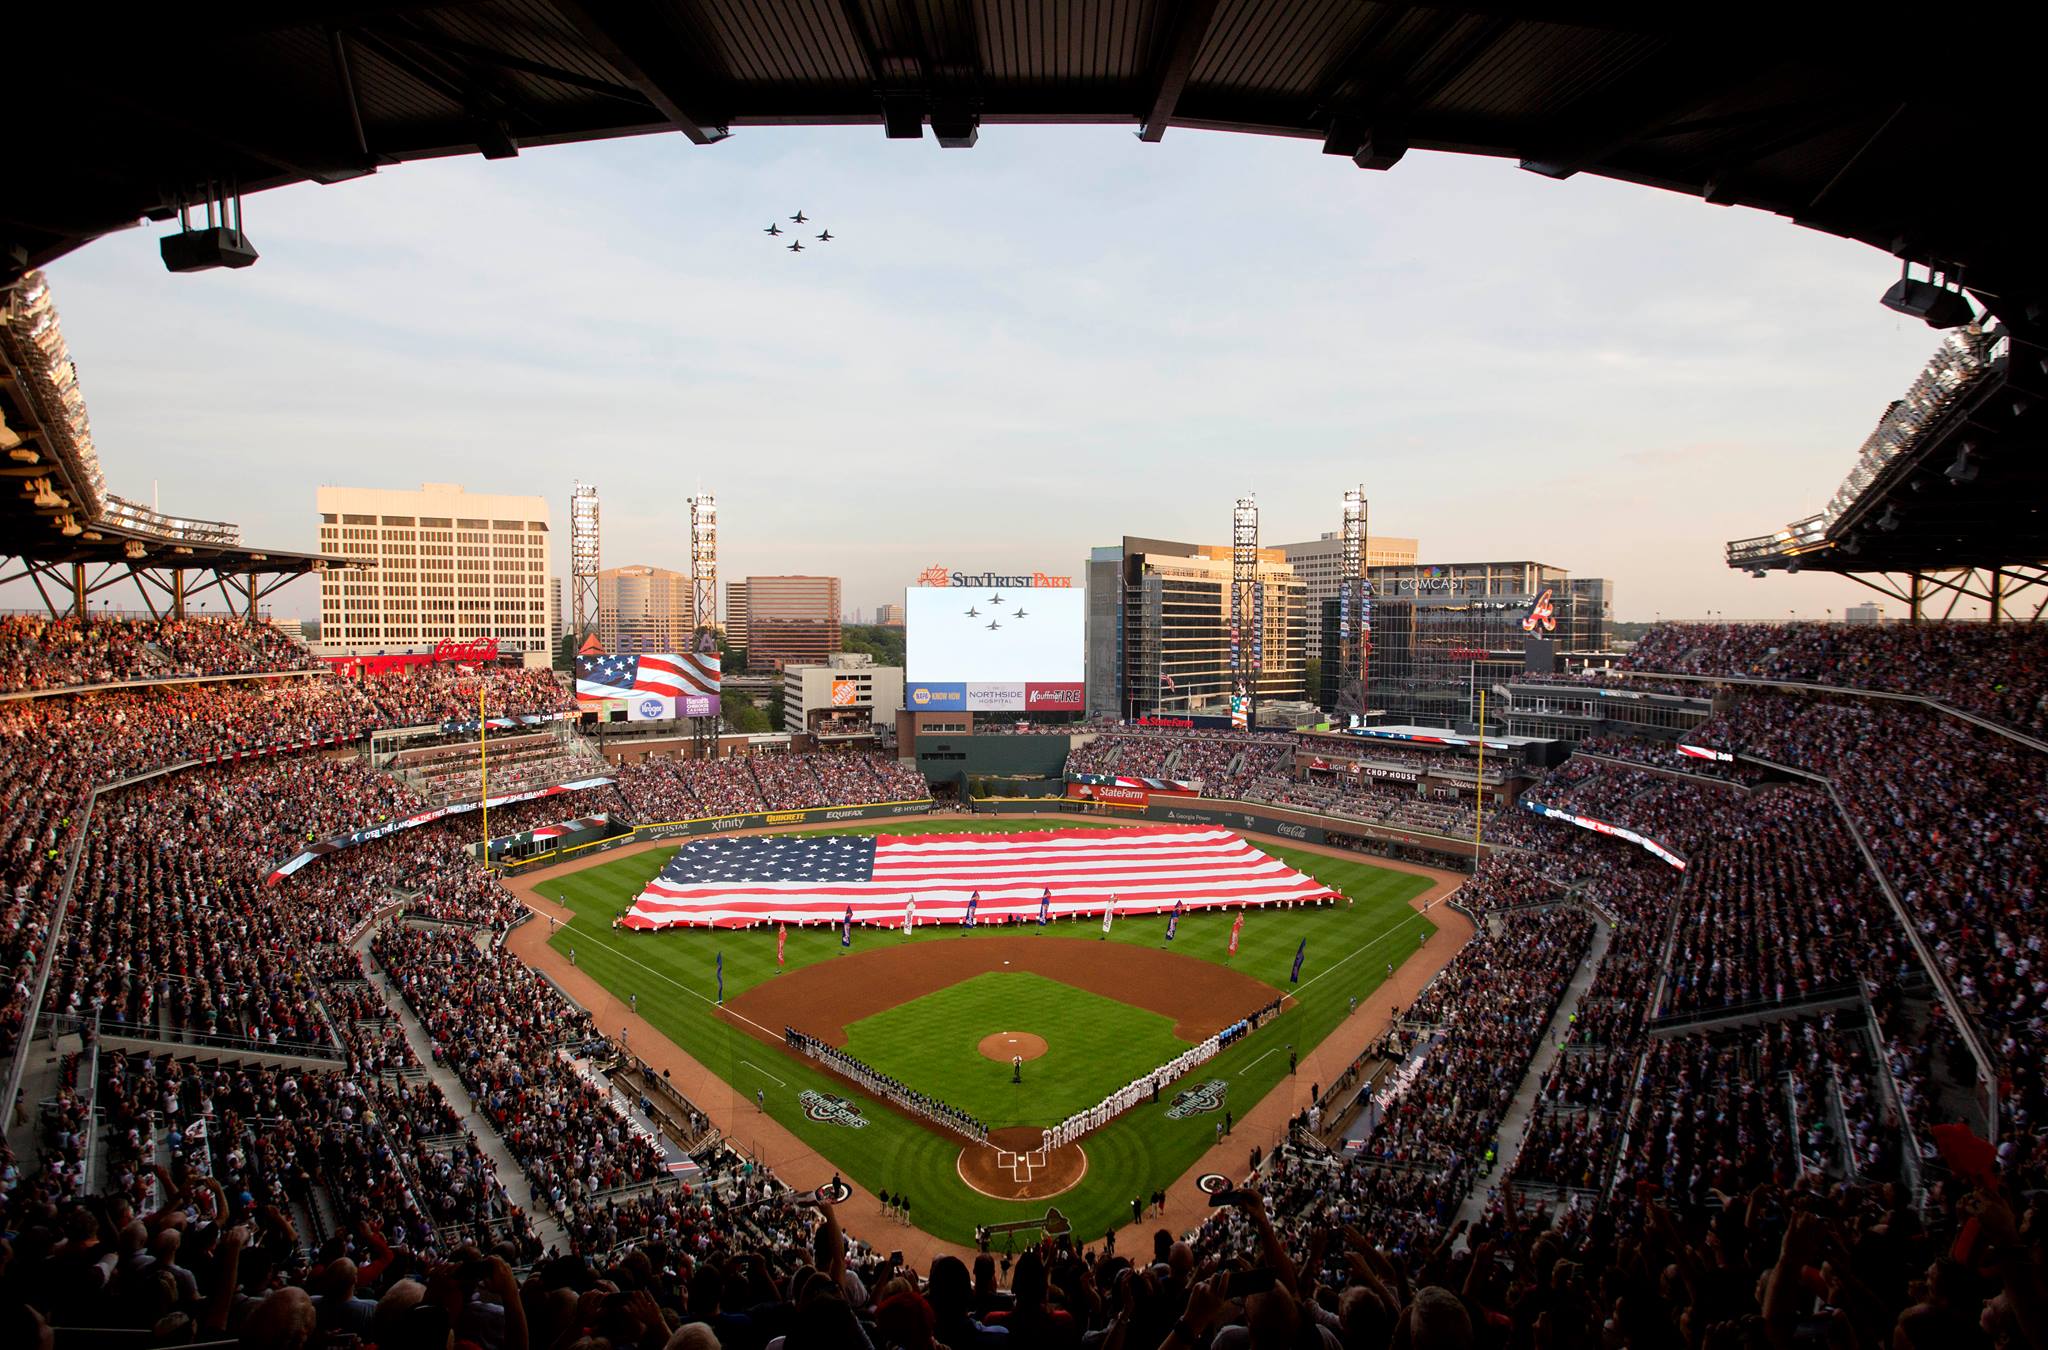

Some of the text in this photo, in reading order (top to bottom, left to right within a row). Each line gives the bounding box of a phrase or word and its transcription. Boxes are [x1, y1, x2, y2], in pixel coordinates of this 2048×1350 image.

[1400, 579, 1464, 590] COMCAST
[1030, 690, 1081, 703] Kauffman TIRE
[641, 702, 662, 716] Kroger
[1329, 763, 1347, 772] LIGHT
[1366, 768, 1417, 781] CHOP HOUSE
[380, 823, 394, 834] THE
[394, 819, 410, 830] LAND
[432, 808, 446, 818] FREE
[446, 805, 460, 814] AND
[464, 802, 477, 810] THE
[523, 788, 549, 799] BRAVE?
[826, 809, 864, 820] EQUIFAX
[1175, 812, 1195, 821] Georgia
[711, 817, 745, 831] xfinity
[766, 813, 806, 823] QUIKRETE
[650, 822, 689, 834] WELLSTAR
